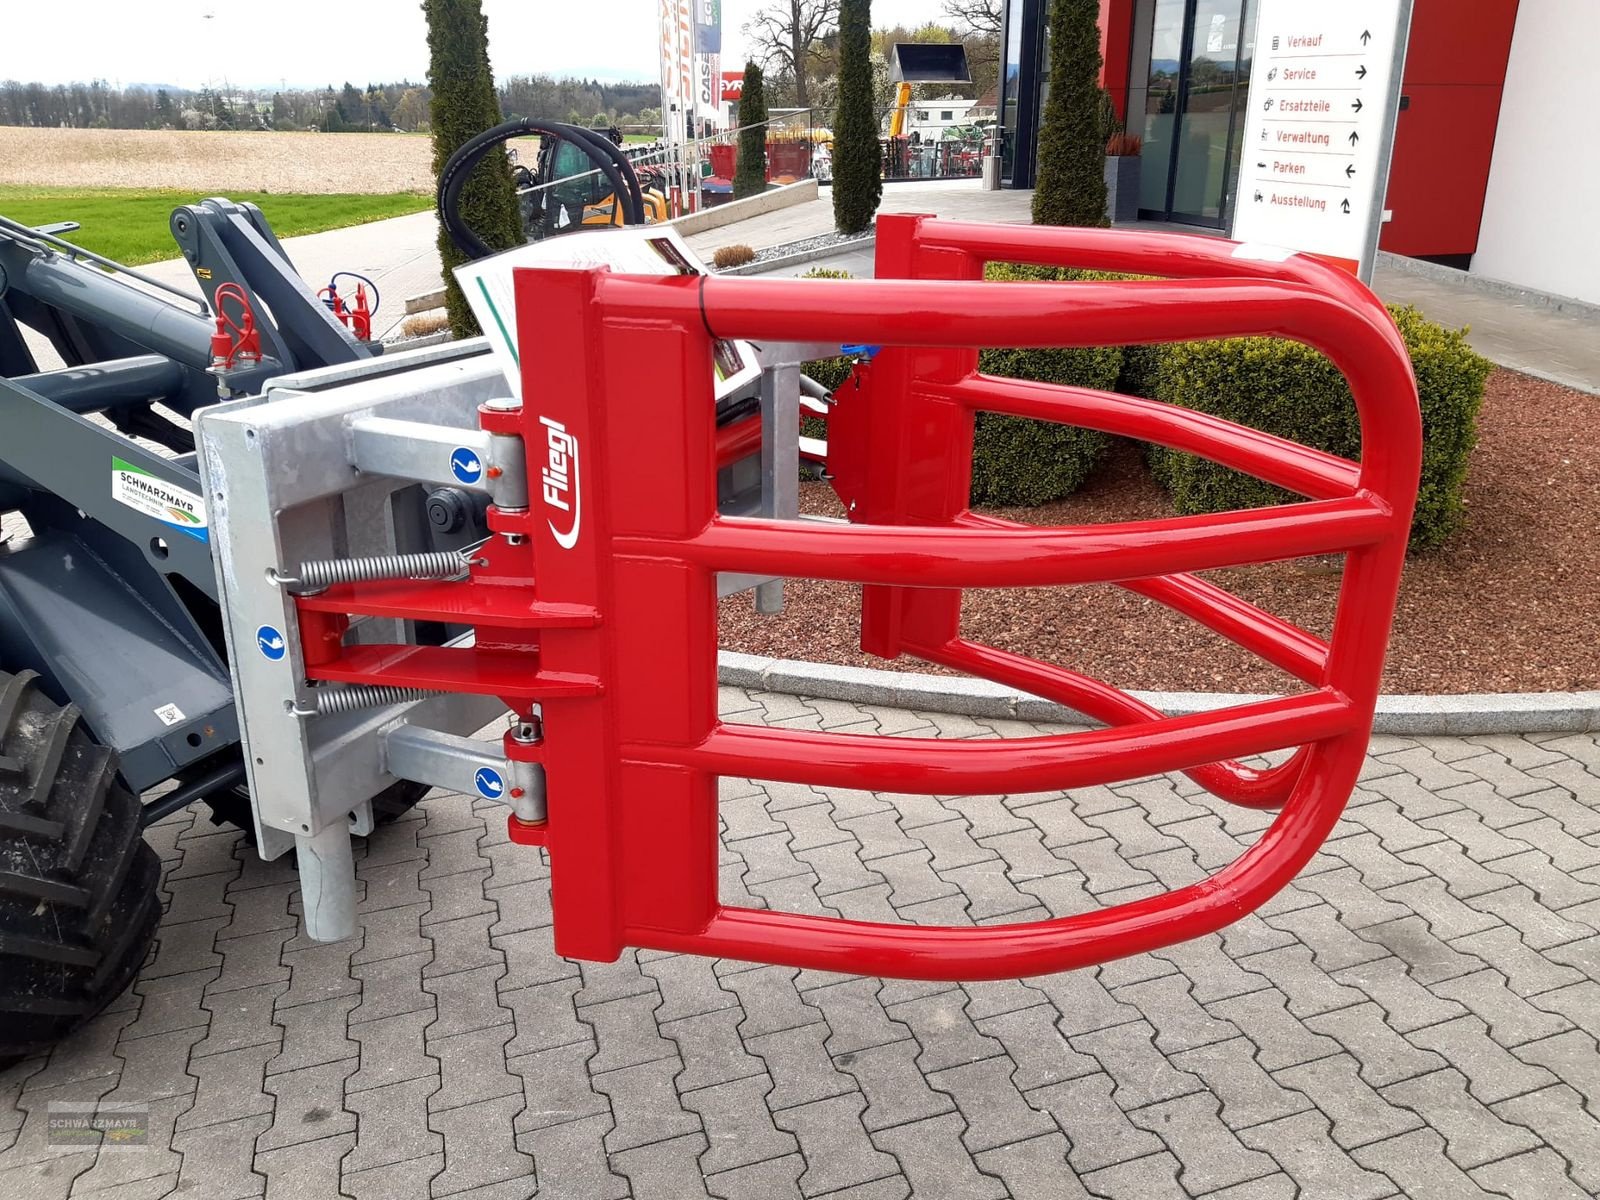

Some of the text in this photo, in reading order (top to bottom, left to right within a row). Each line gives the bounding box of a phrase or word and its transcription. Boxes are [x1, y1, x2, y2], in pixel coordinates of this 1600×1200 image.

[1287, 34, 1323, 48] Verkauf
[1283, 68, 1317, 80] Service
[1279, 99, 1330, 112] Ersatzteile
[1276, 130, 1330, 146] Verwaltung
[1273, 161, 1306, 175] Parken
[1270, 193, 1326, 211] Ausstellung
[539, 415, 574, 512] Fliegl
[120, 472, 194, 512] SCHWARZMAYR
